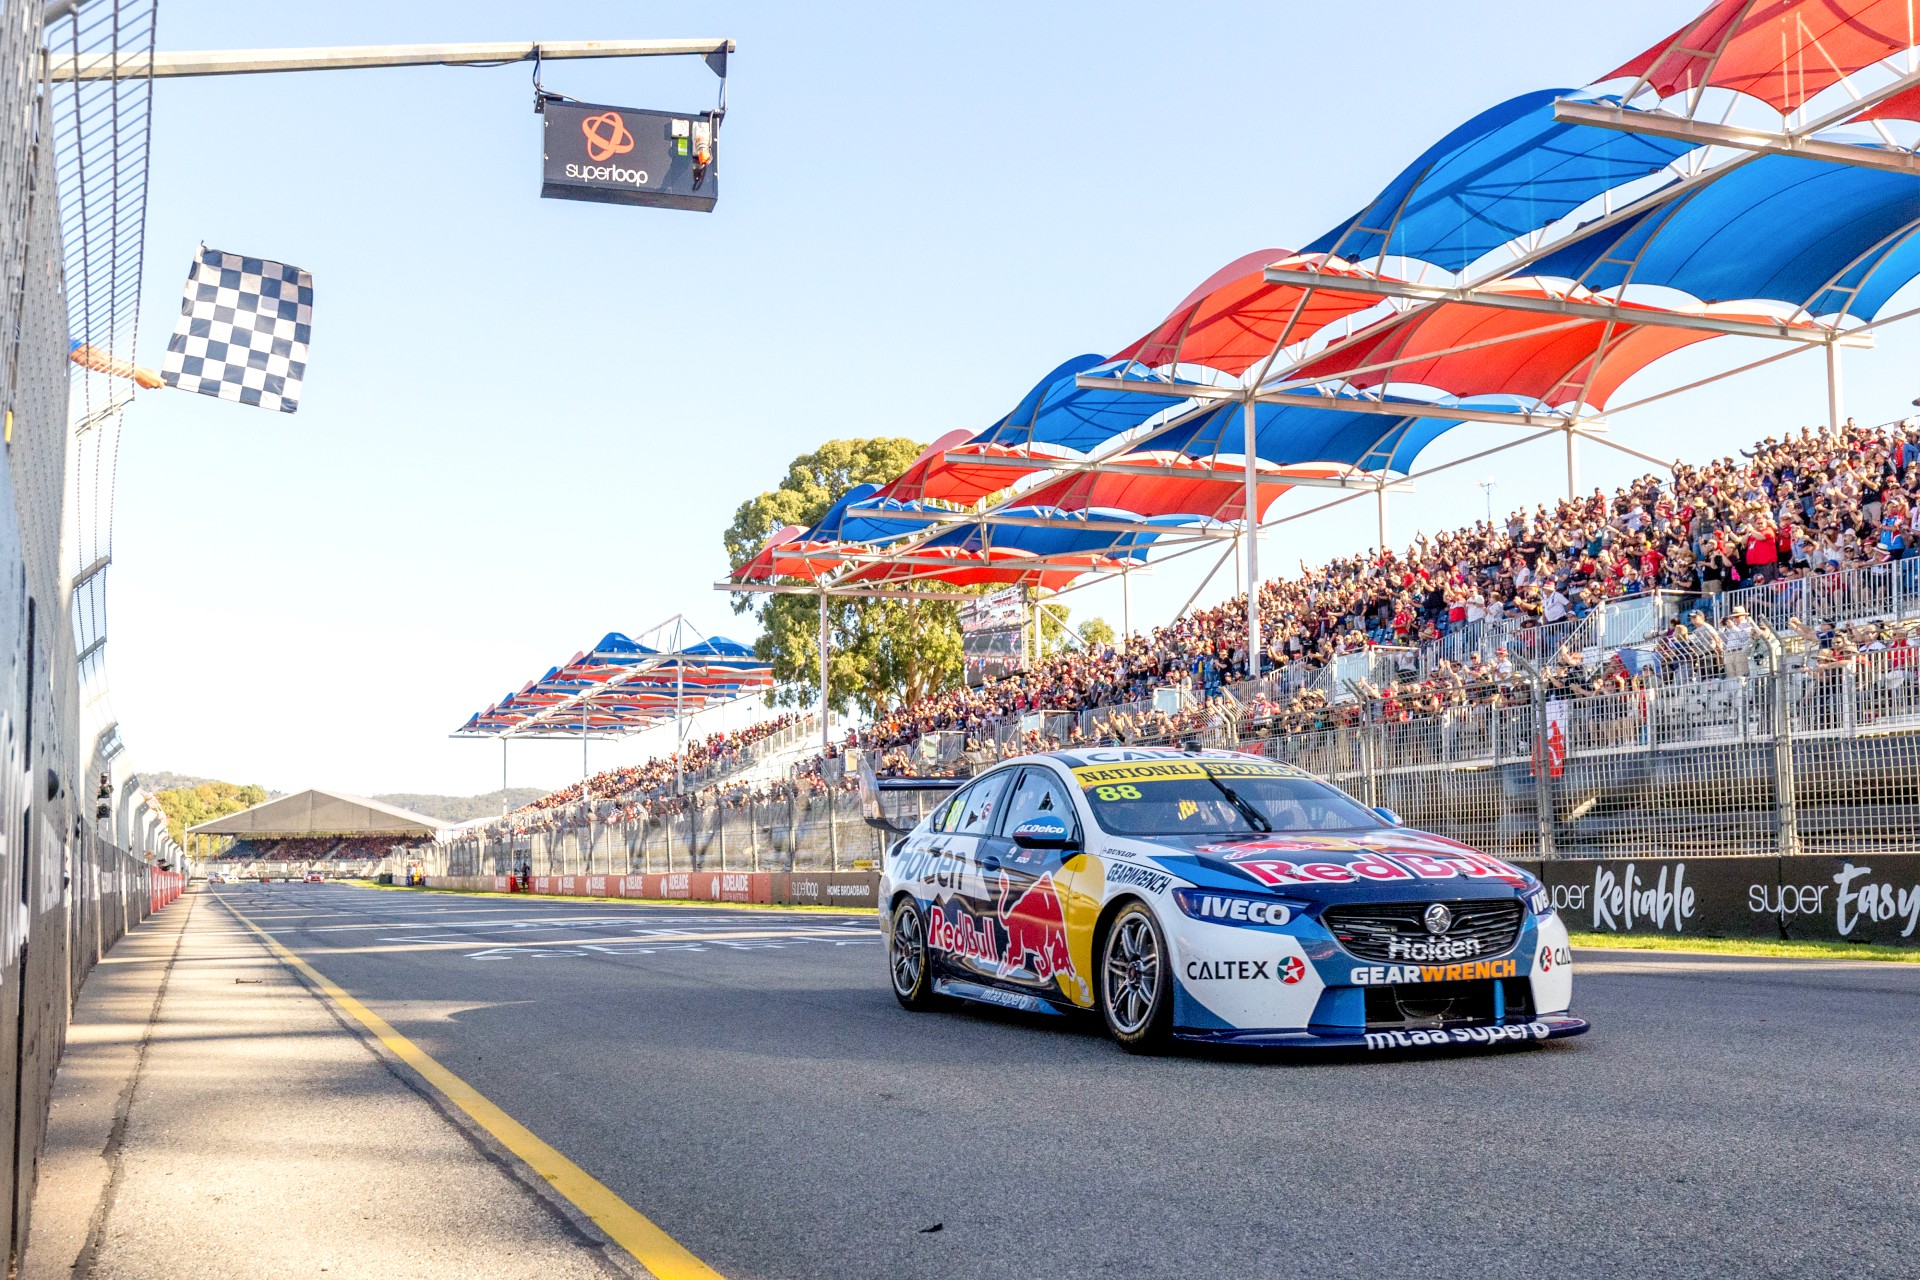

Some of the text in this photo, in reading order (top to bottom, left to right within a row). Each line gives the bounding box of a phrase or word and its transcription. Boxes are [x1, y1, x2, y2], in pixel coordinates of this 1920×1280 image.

[566, 164, 648, 187] superloop
[1078, 763, 1305, 782] NATIONAL STORAGE
[1096, 784, 1142, 801] 88
[946, 800, 966, 826] 88
[1016, 825, 1065, 834] ACDelco
[894, 837, 967, 890] Holden
[1106, 848, 1137, 858] DUNLOP
[723, 875, 748, 892] ADELAIDE
[791, 878, 870, 900] superloop HOME BROADBAND
[1107, 863, 1172, 895] GEARWRENCH
[1550, 862, 1695, 932] uper Reliable
[1748, 863, 1920, 937] super Easy
[1201, 896, 1291, 926] IVECO
[1388, 934, 1481, 961] Holden
[1187, 961, 1270, 980] CALTEX
[1350, 960, 1516, 985] GEARWRENCH
[1364, 1024, 1529, 1050] mtaa super
